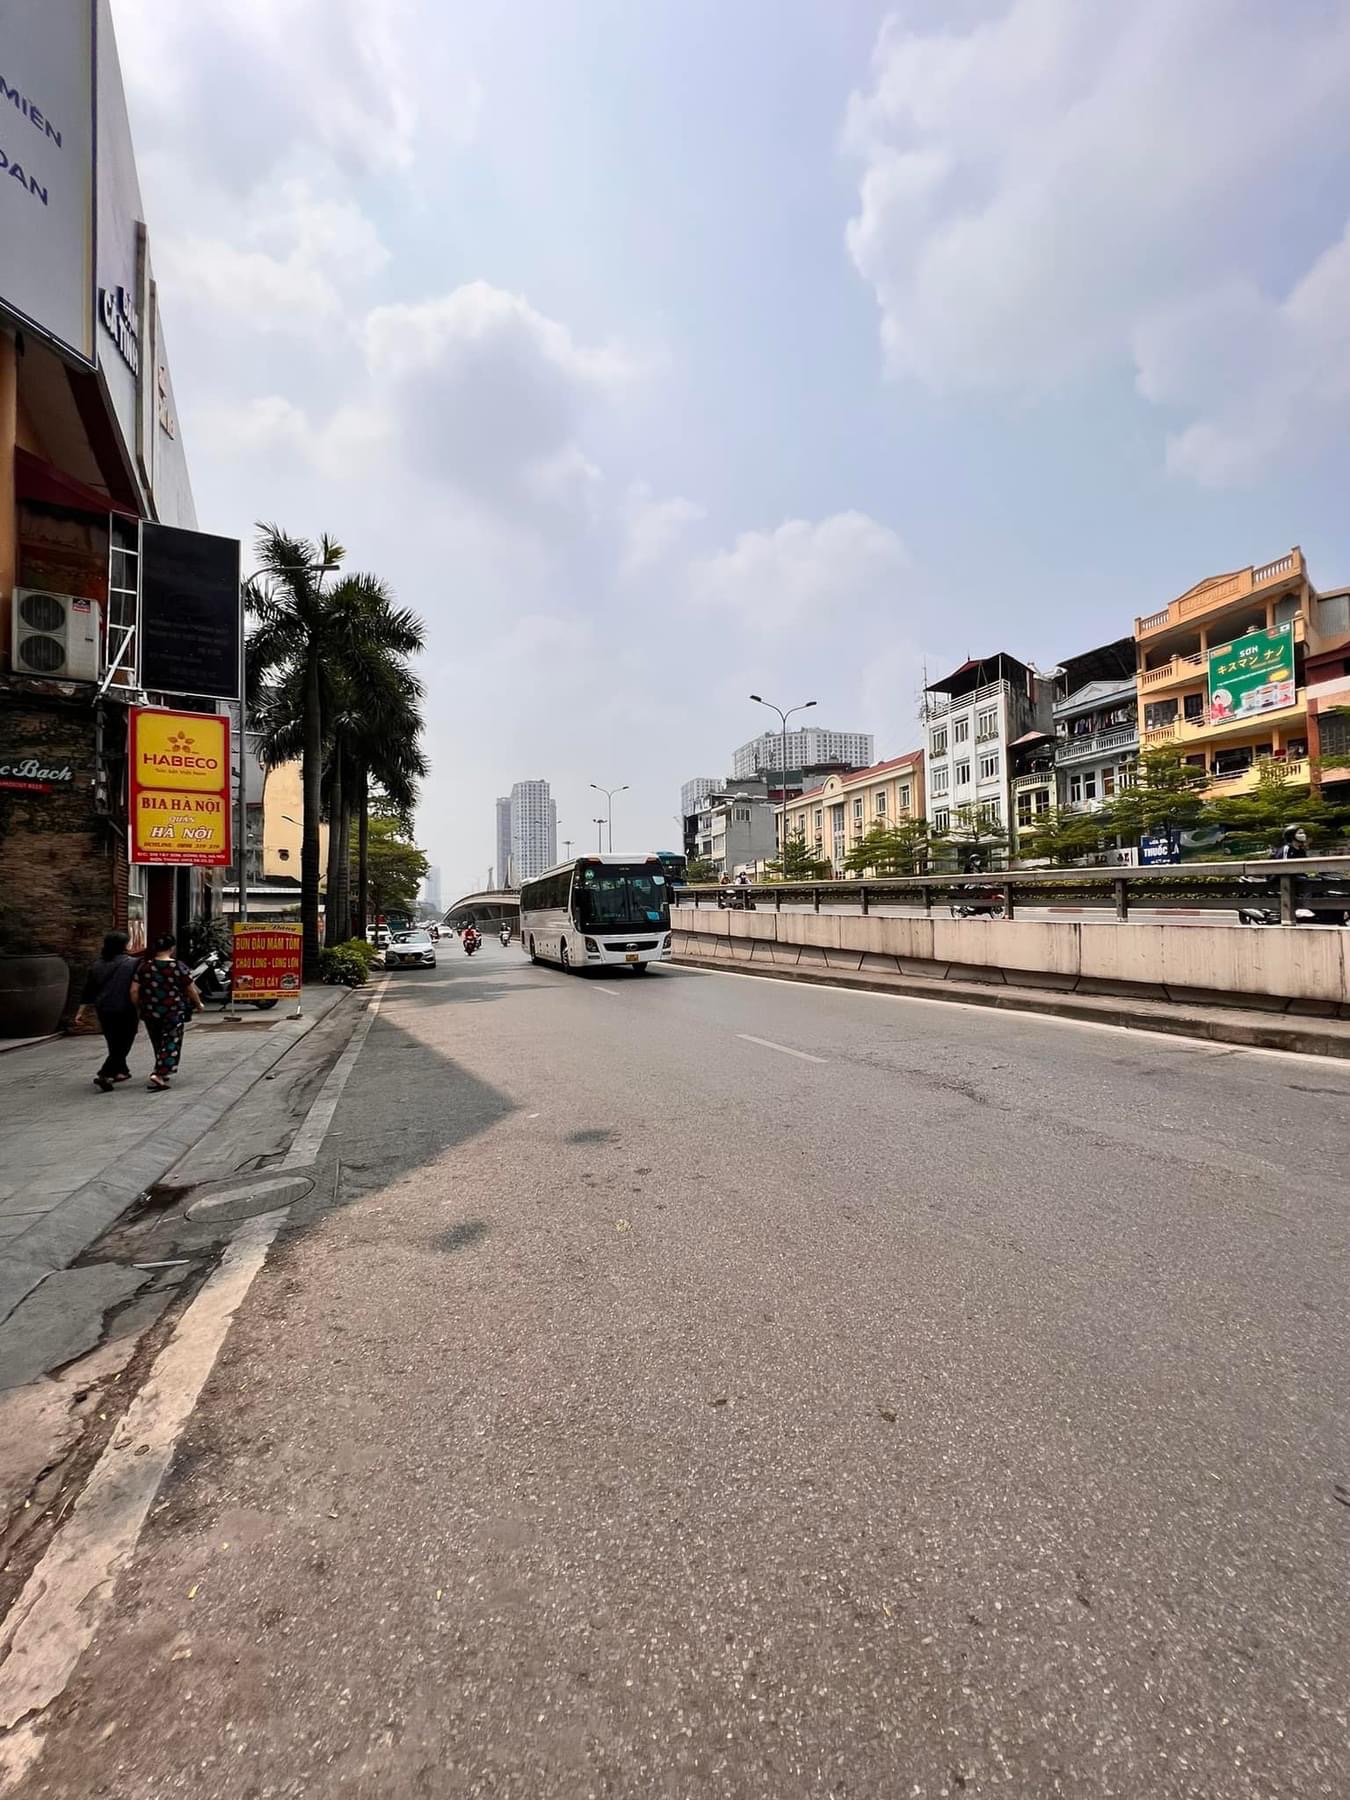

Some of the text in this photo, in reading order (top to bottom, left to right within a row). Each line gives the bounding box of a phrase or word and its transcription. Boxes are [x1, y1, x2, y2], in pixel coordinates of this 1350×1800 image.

[12, 759, 73, 782] Bạch
[143, 753, 218, 770] HABECO
[141, 796, 220, 815] BIA HÀ NỘI
[151, 824, 213, 842] HÀ NỘI
[1143, 843, 1168, 858] THUỐC
